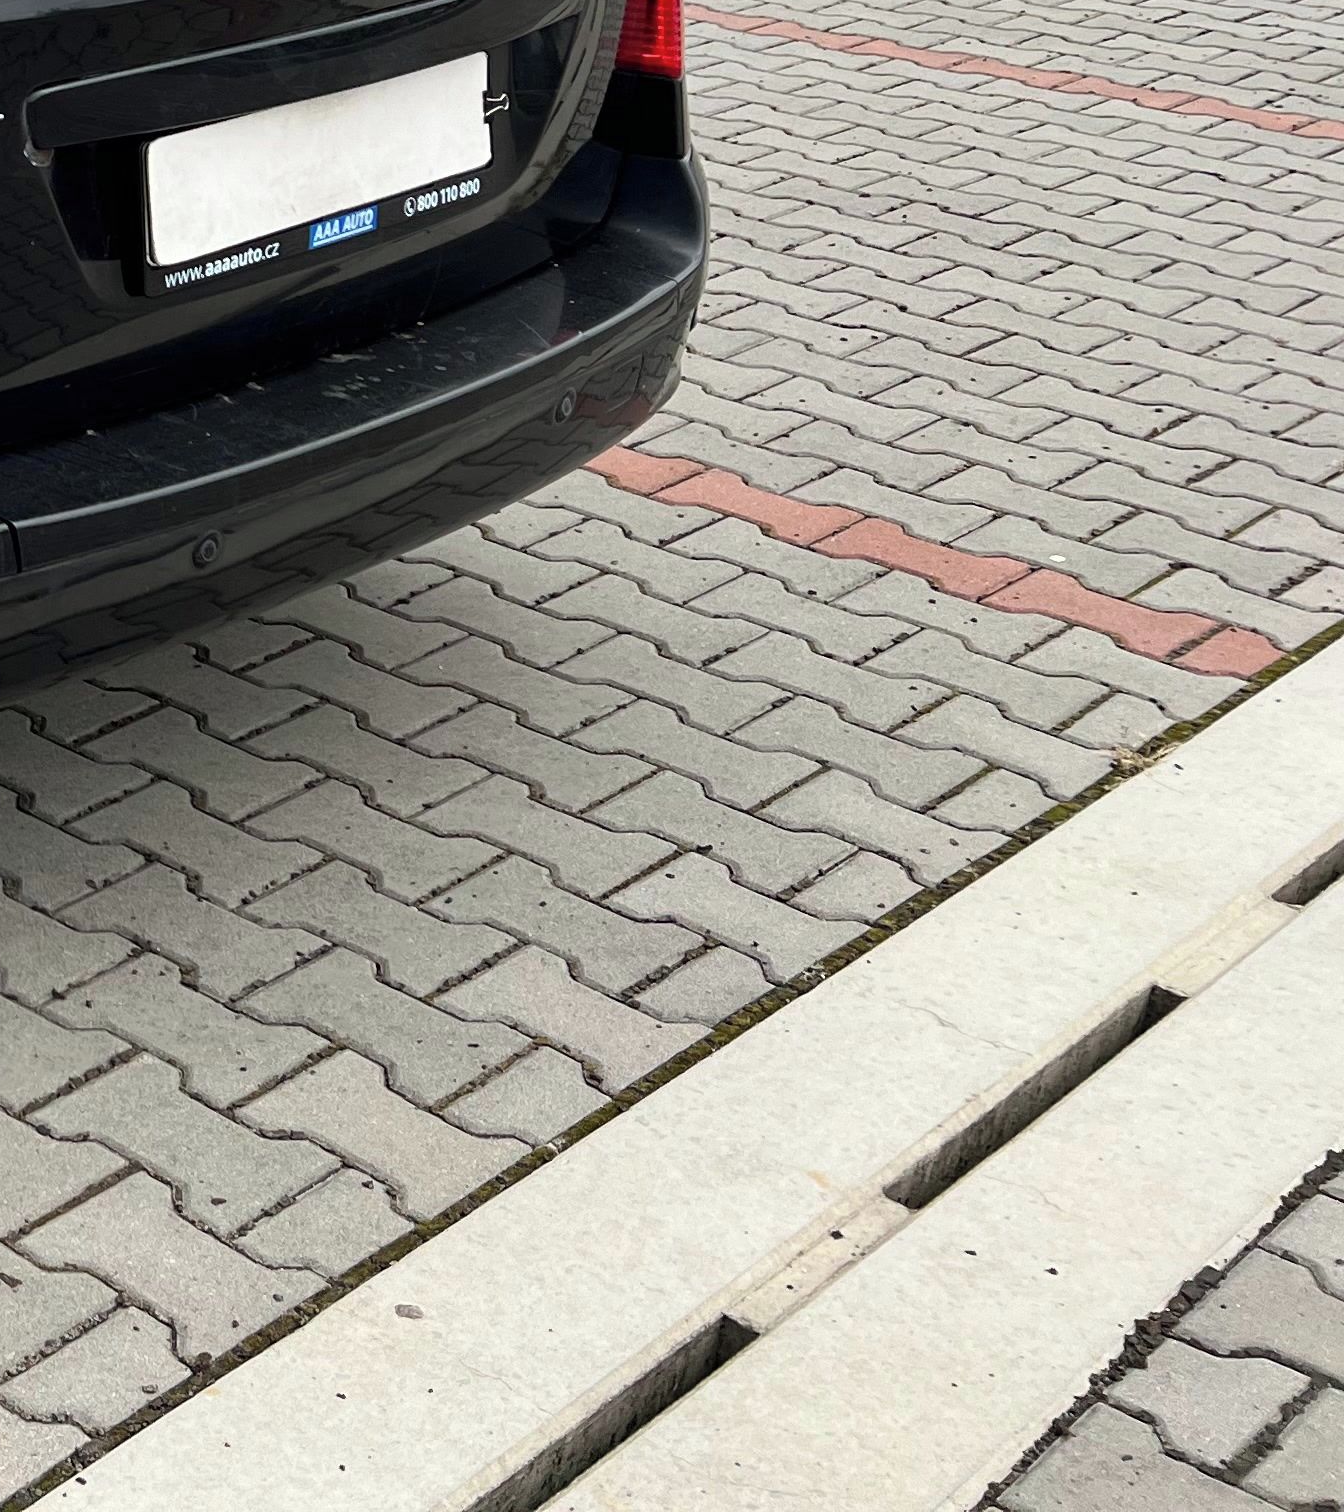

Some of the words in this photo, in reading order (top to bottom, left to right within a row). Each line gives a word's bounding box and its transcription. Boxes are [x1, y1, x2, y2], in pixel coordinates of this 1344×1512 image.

[417, 191, 439, 213] 800
[440, 184, 458, 205] 110
[459, 177, 481, 199] 800
[313, 219, 341, 242] AAA
[342, 208, 374, 234] AUTO
[164, 241, 281, 289] www.aaaauto.cz
